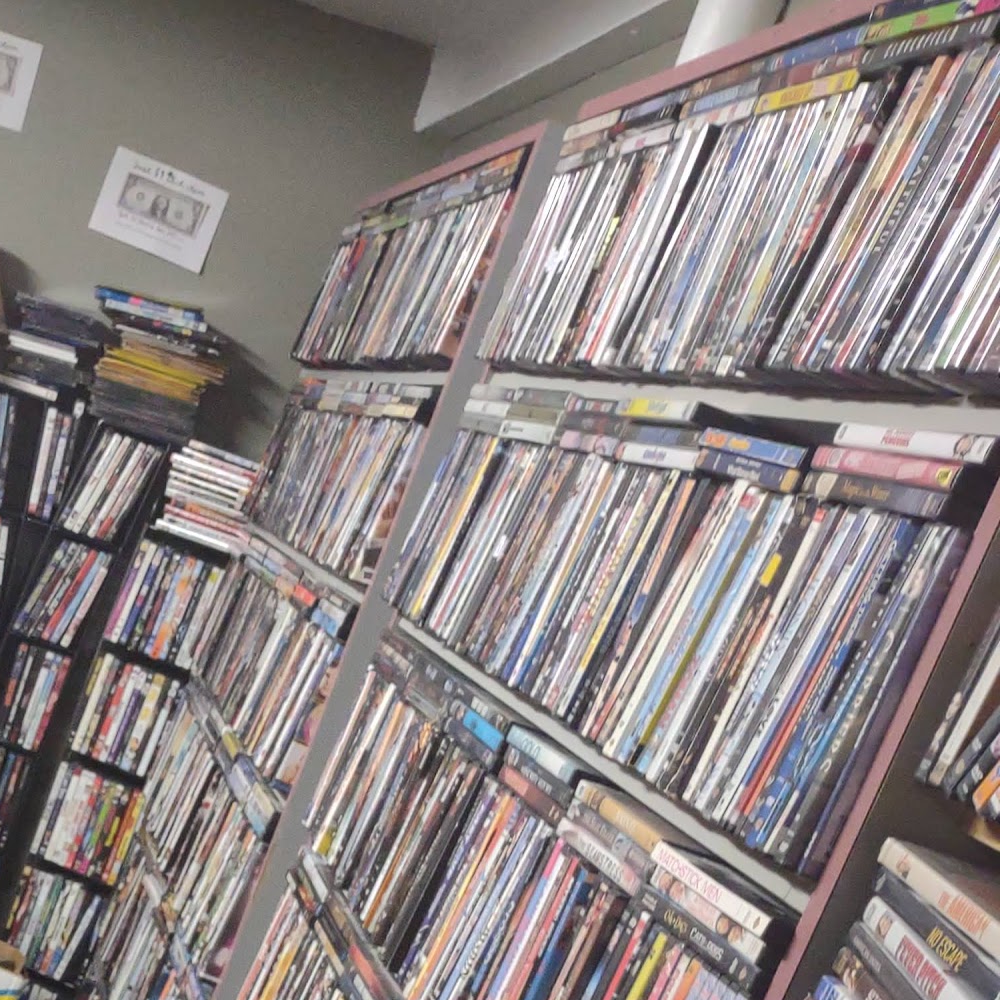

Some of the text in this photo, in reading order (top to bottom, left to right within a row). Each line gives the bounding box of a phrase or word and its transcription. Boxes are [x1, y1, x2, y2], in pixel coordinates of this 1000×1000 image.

[700, 881, 723, 902] MEN
[924, 926, 969, 972] NO ESCAPE
